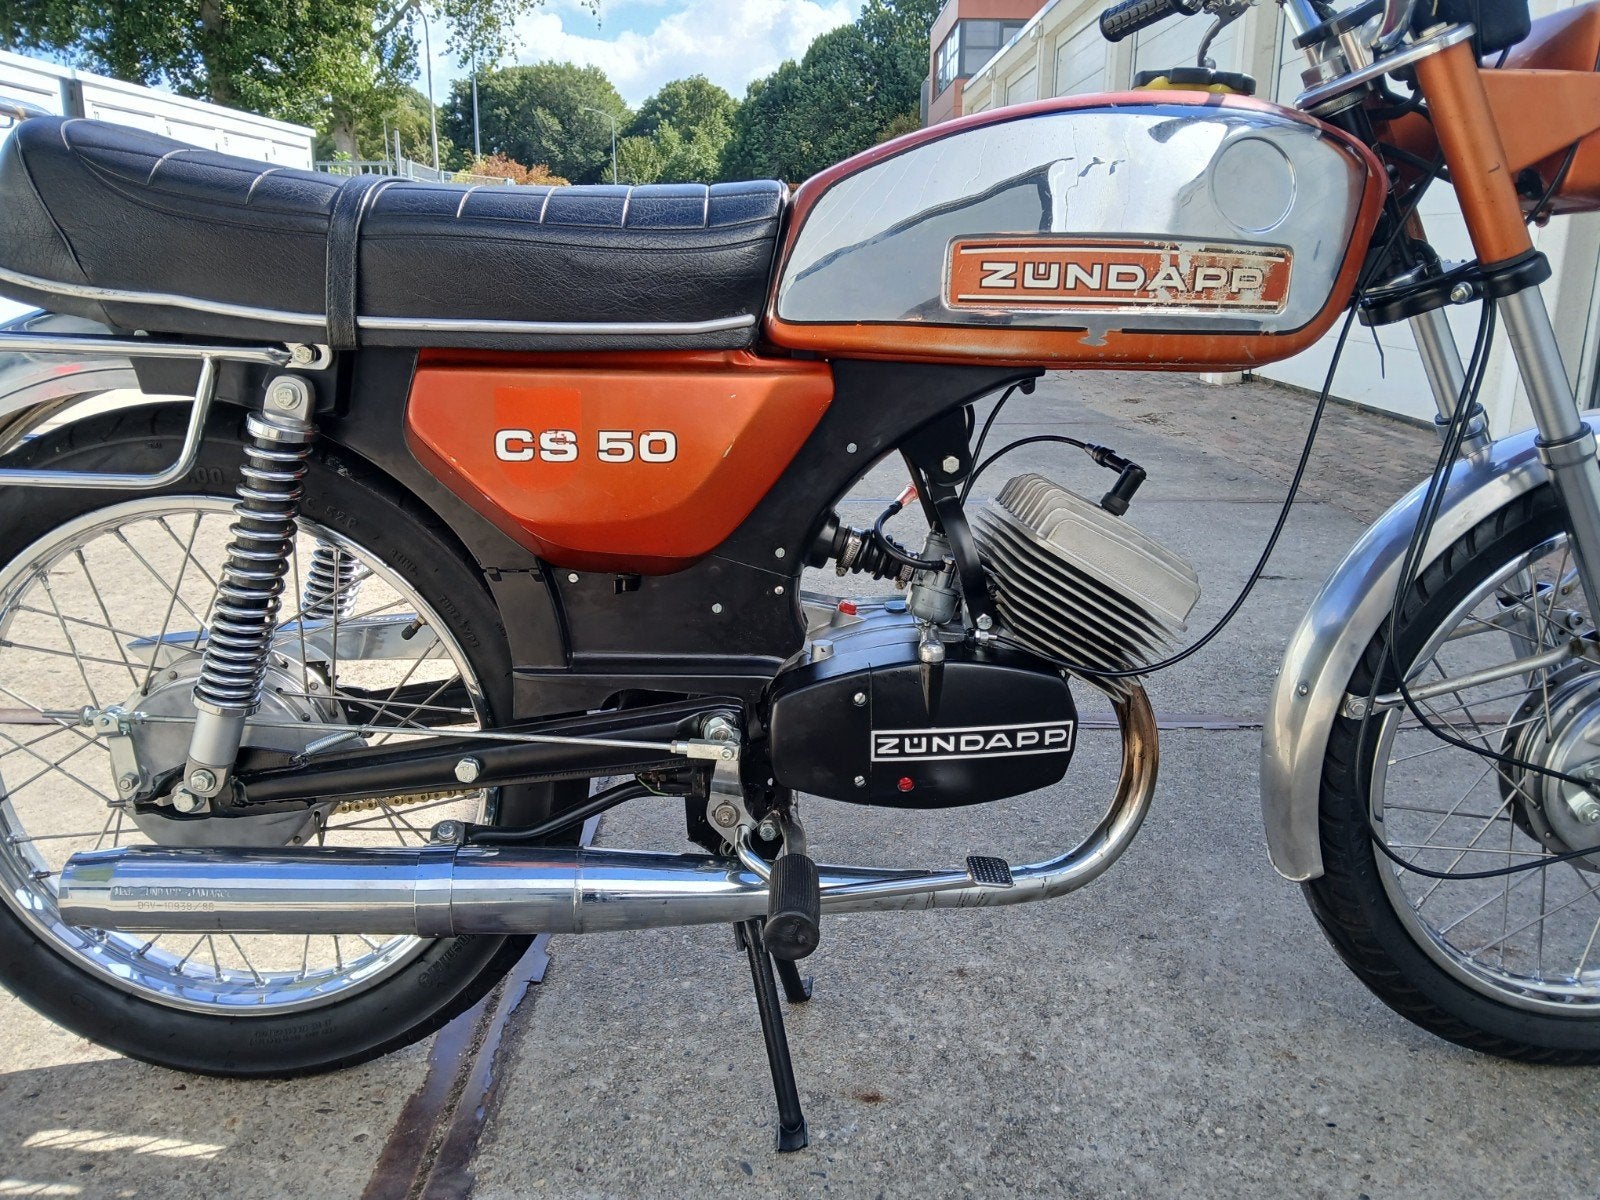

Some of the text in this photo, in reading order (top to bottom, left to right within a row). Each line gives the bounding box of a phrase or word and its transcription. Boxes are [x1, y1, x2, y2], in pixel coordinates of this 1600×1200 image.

[979, 260, 1265, 294] ZÜNDAPP
[494, 428, 678, 463] CS 50
[876, 729, 1067, 754] ZÜNDAPP
